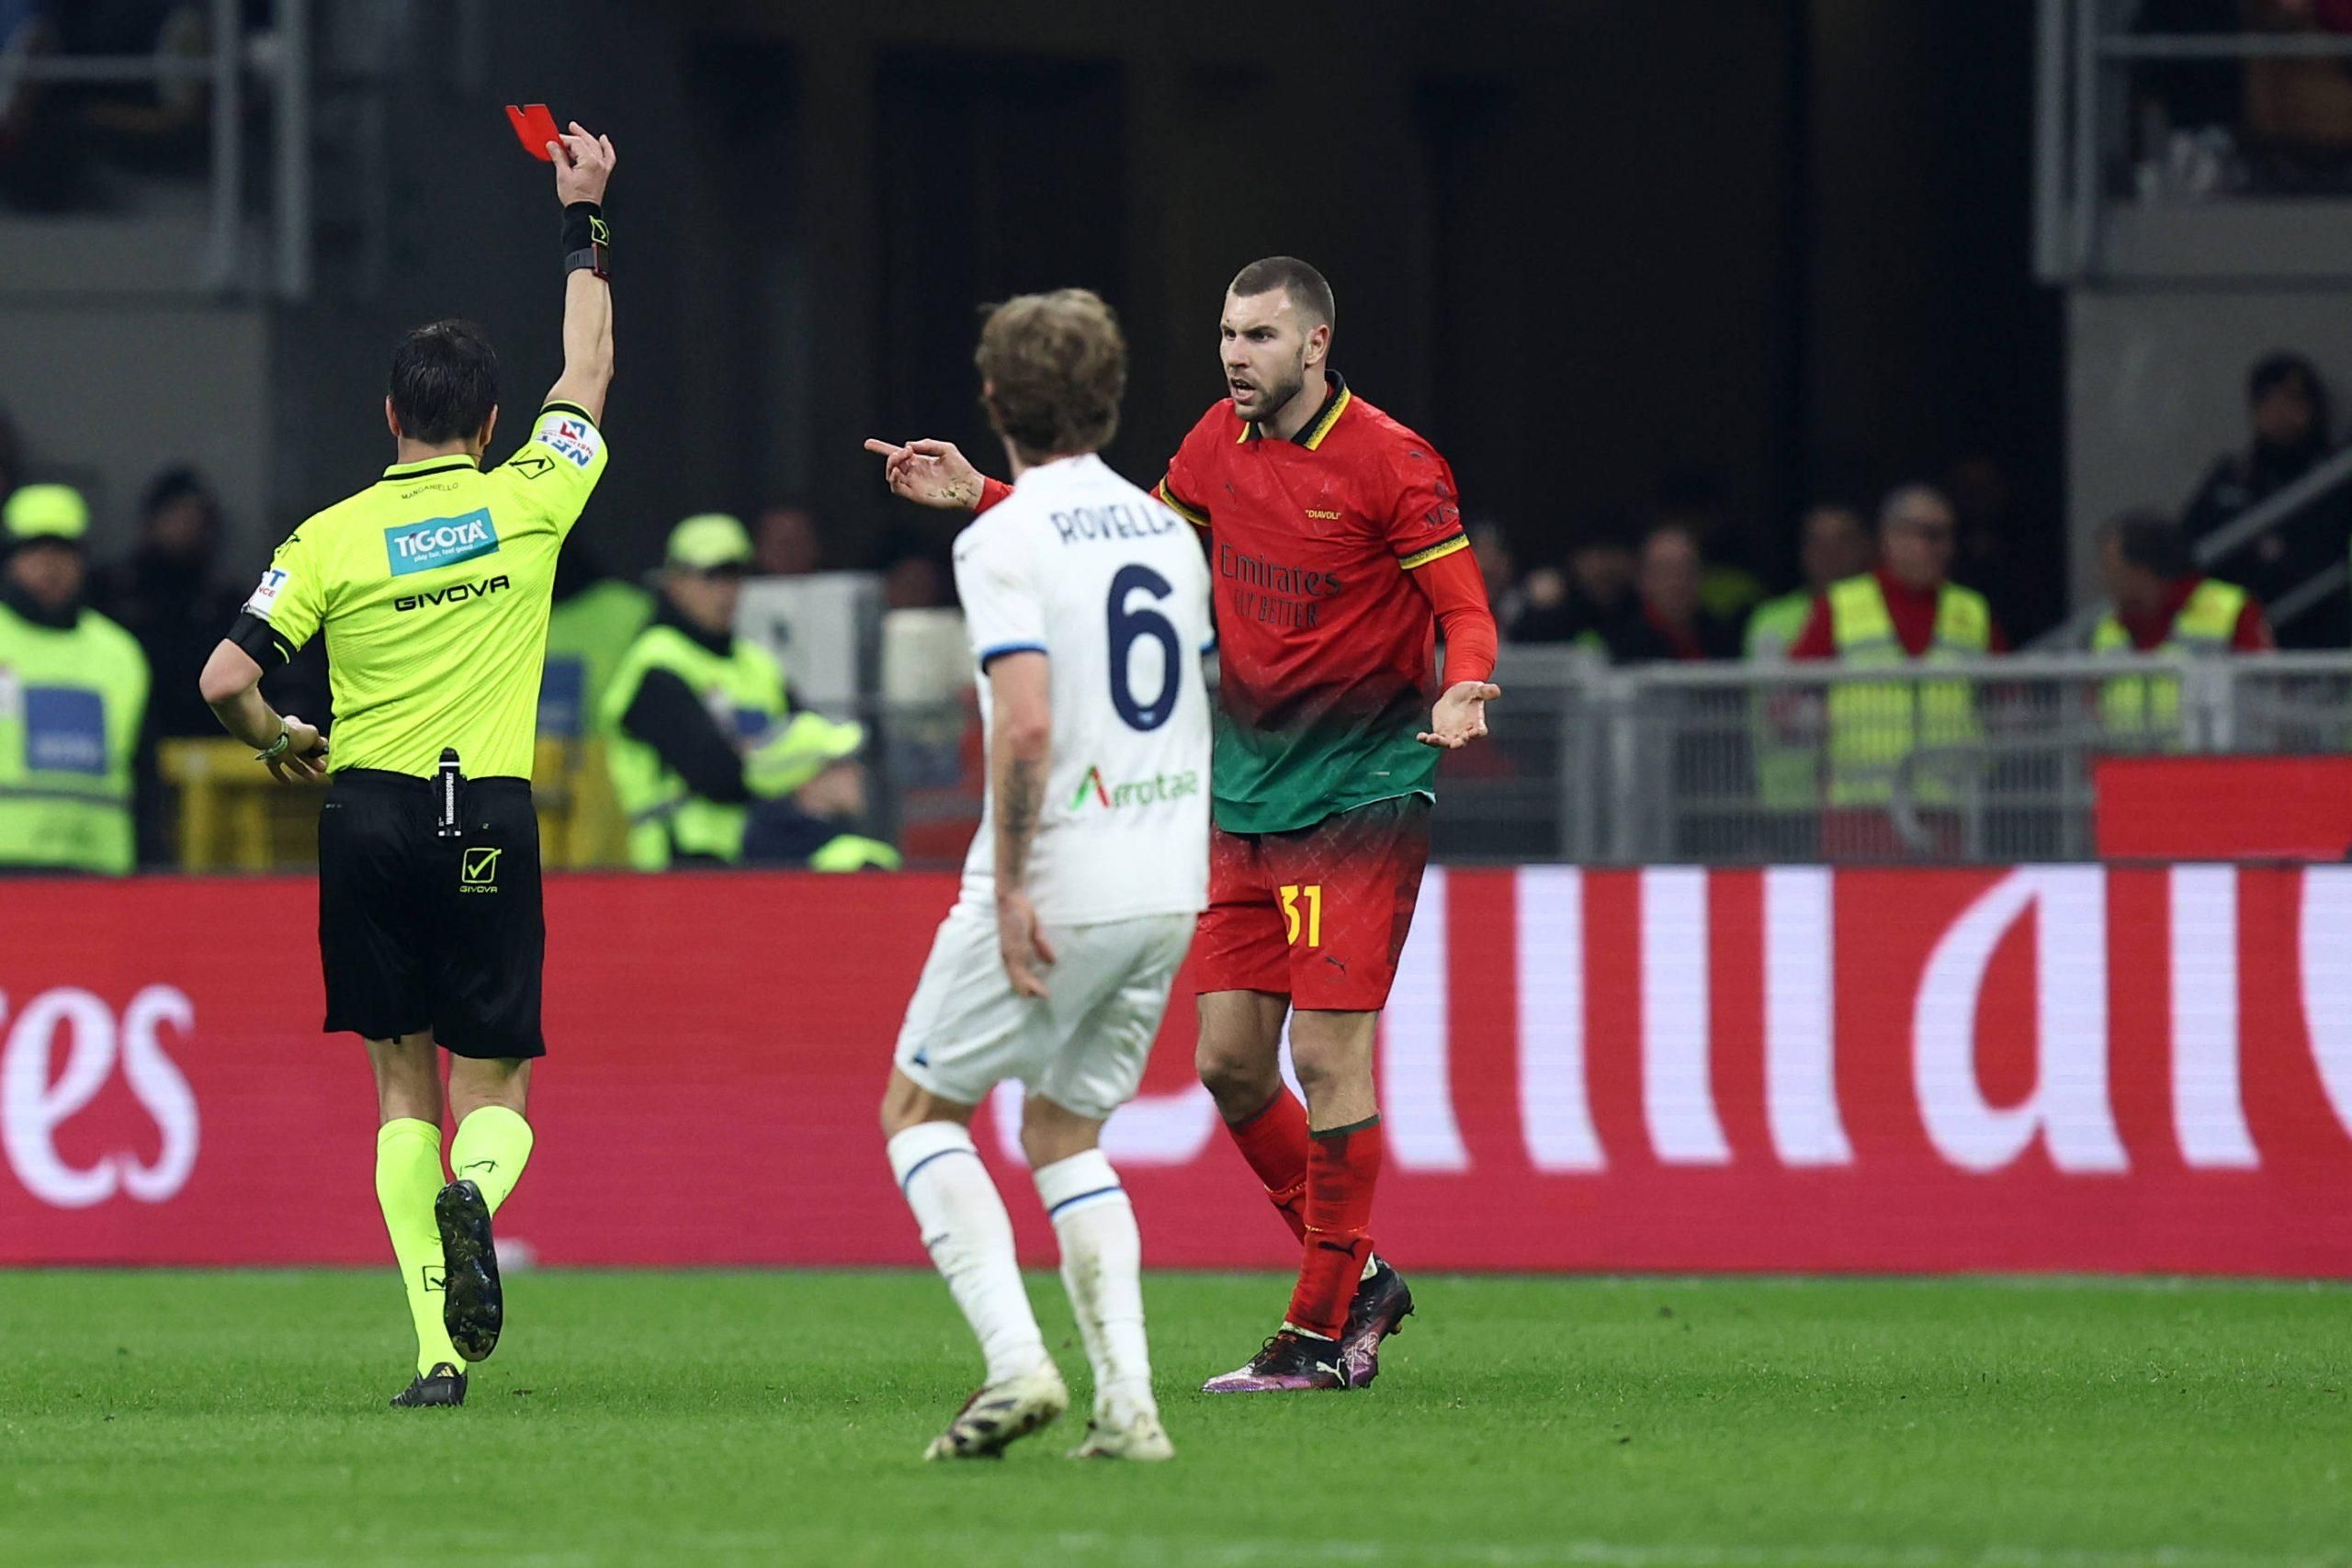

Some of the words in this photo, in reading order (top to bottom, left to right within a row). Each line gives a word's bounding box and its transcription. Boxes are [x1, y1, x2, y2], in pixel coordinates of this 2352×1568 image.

[401, 482, 458, 500] MANGANIELLO
[1050, 503, 1180, 545] ROVELLA
[1221, 542, 1342, 596] Emirates
[394, 575, 510, 612] GIVOVA
[1258, 595, 1318, 628] BETTER
[1107, 563, 1182, 731] 6
[1279, 885, 1322, 948] 31
[0, 983, 201, 1208] es
